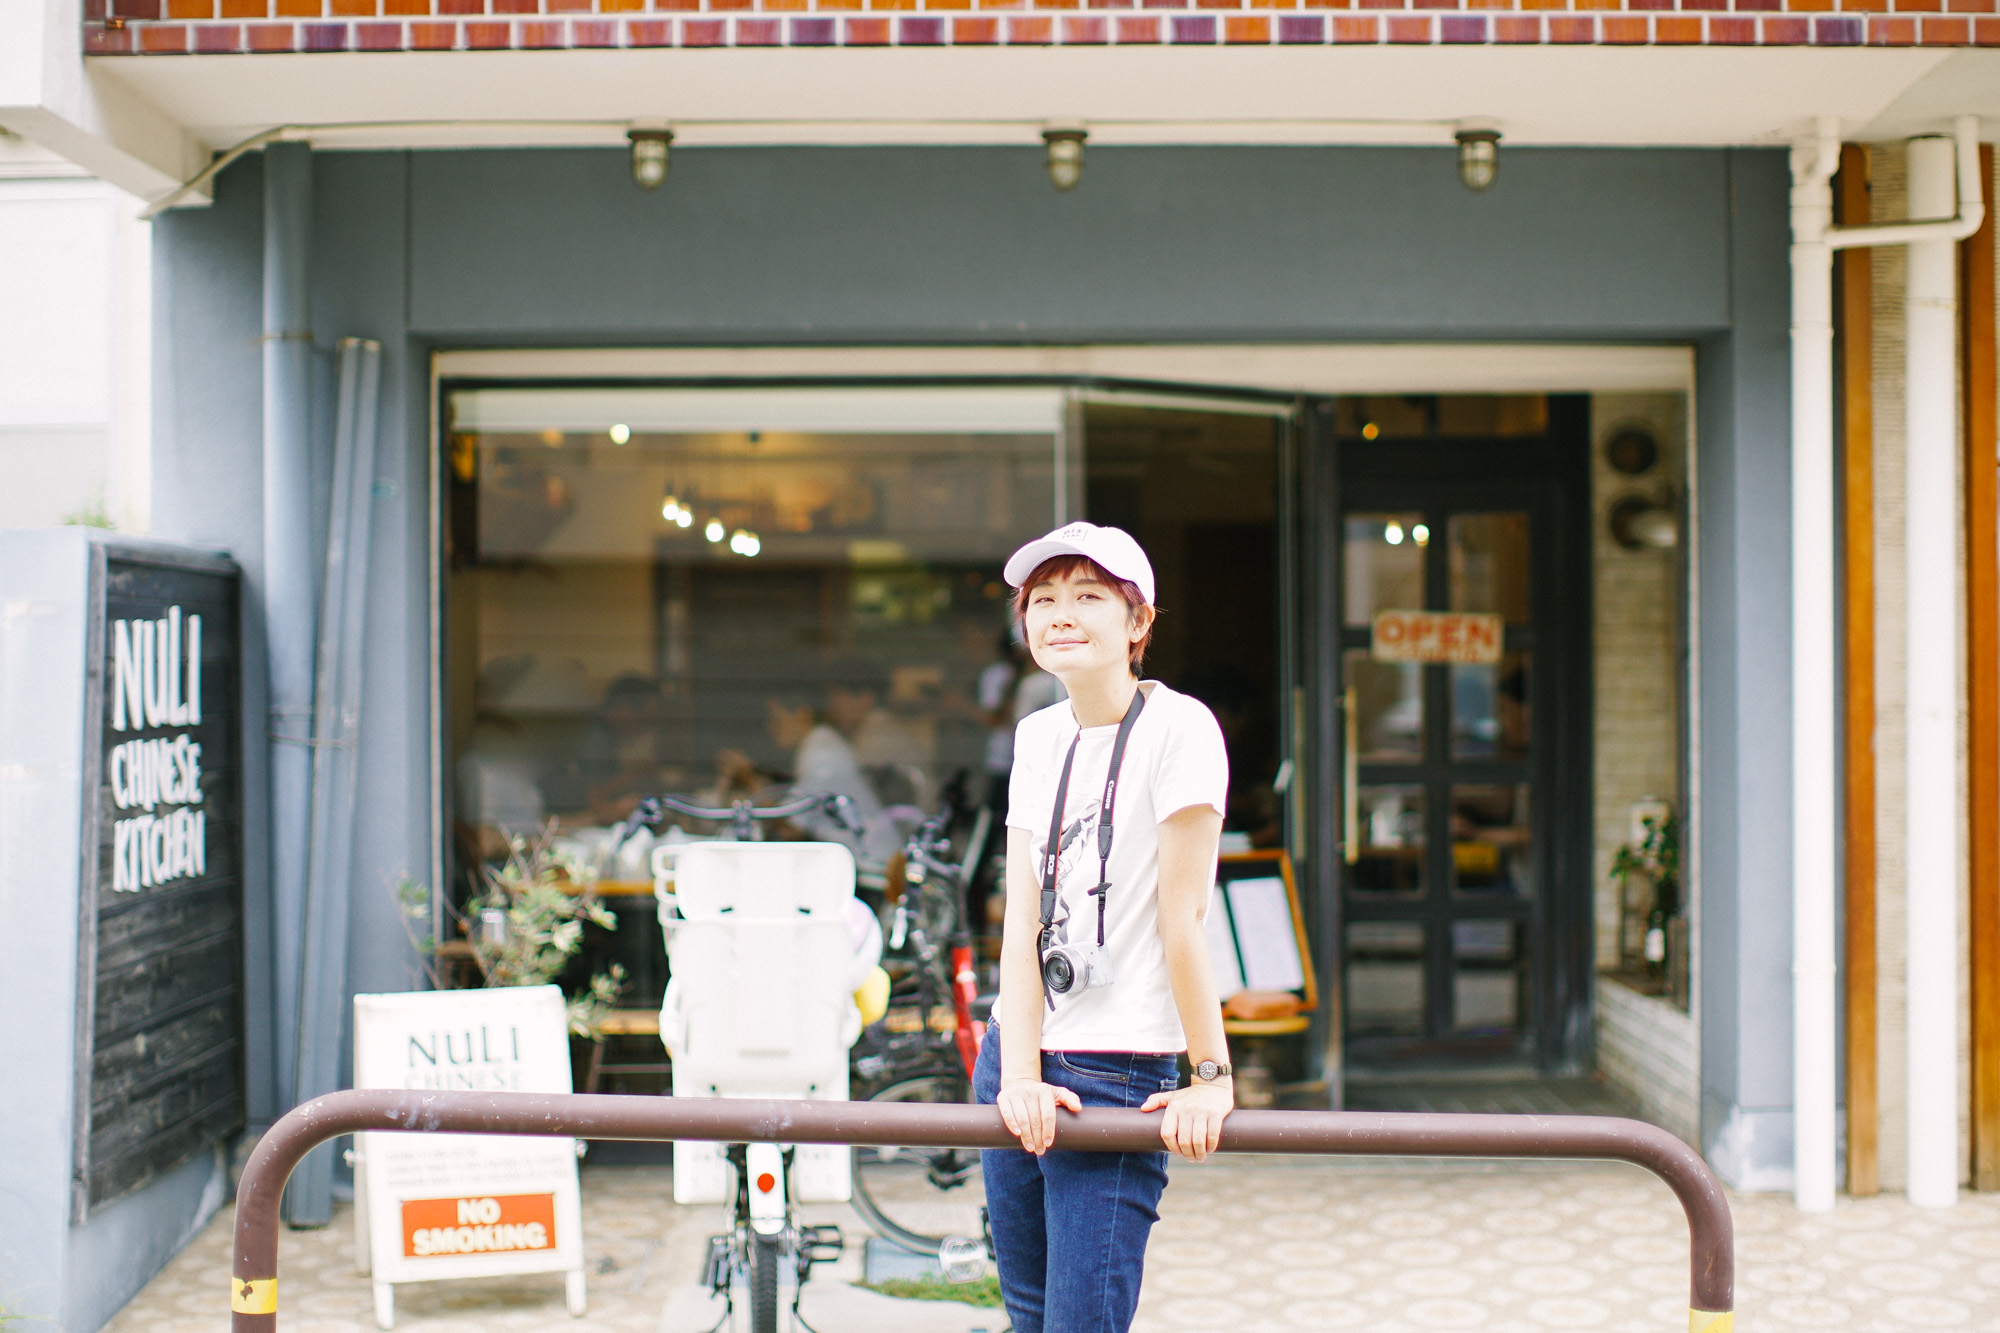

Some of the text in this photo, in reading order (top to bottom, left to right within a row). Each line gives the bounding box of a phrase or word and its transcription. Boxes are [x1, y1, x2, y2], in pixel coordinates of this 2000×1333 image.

[1376, 615, 1496, 651] OPEN
[112, 604, 202, 731] NULI
[111, 733, 203, 811] CHINESE
[1104, 779, 1115, 809] Canon
[113, 806, 205, 892] KITCHEN
[1047, 853, 1056, 875] EOS
[409, 1025, 519, 1067] NULI
[405, 1068, 523, 1091] CHINESE
[456, 1197, 501, 1225] NO
[412, 1221, 548, 1256] SMOKING
